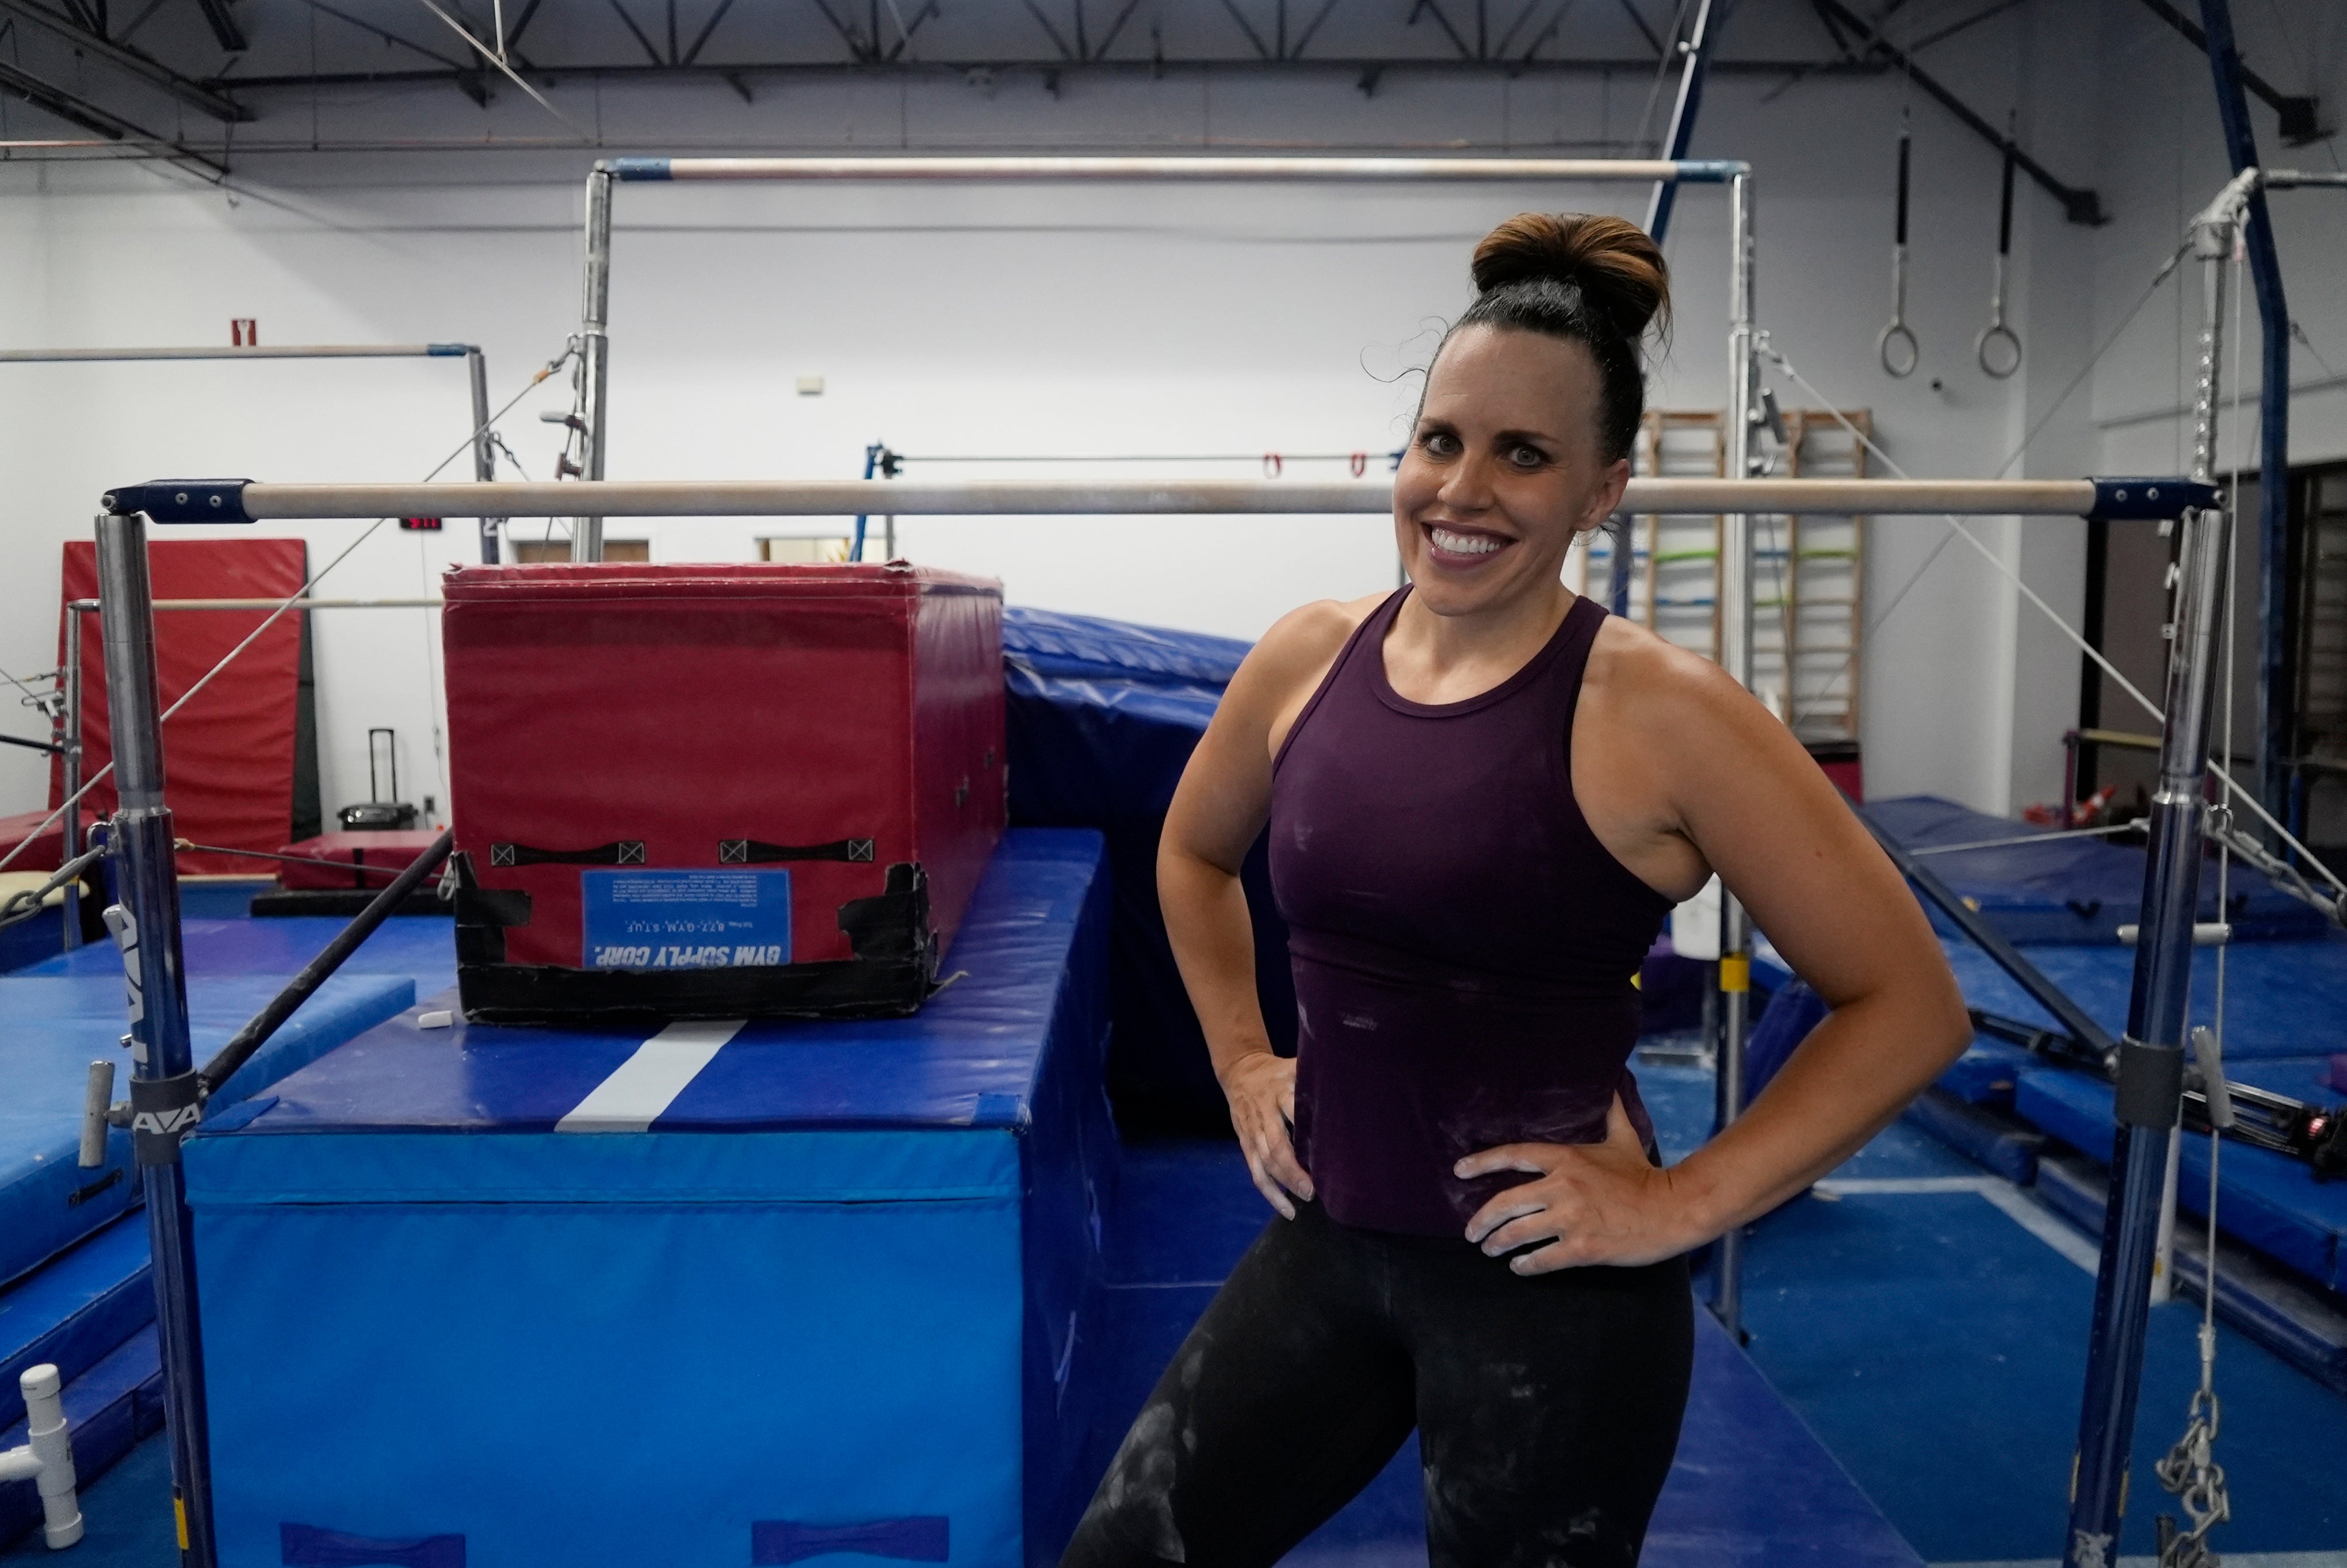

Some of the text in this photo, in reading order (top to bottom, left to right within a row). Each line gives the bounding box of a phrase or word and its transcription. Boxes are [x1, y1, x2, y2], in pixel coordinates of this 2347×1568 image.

[594, 945, 781, 966] GYM SUPPLY CORP.
